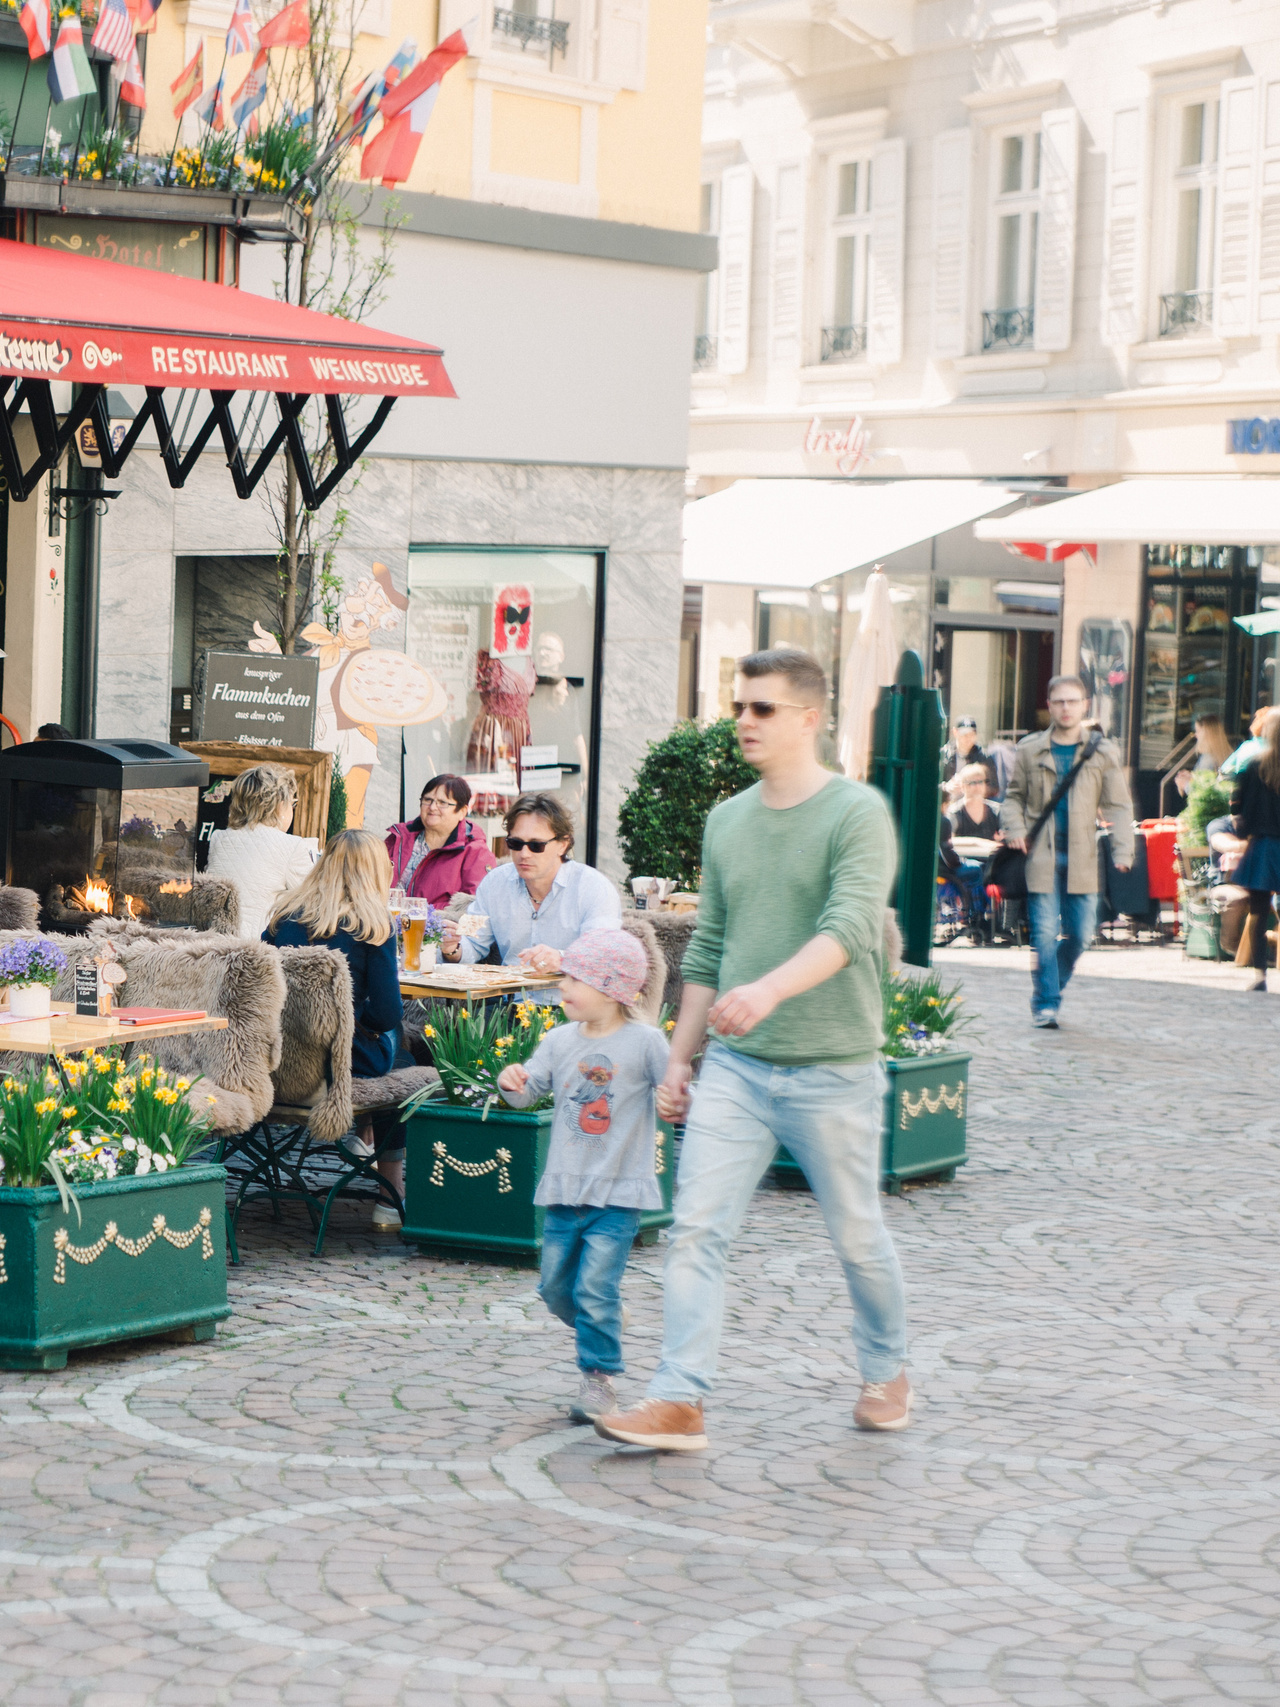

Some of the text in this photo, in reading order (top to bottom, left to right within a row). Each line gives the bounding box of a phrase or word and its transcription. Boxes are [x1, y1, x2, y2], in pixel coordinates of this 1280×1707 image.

[92, 234, 164, 267] Hotel
[152, 346, 430, 387] RESTAURANT WEINSTUBE
[212, 683, 311, 707] Flammkuchen
[235, 711, 285, 723] aus dem Ofen
[268, 737, 283, 747] Art
